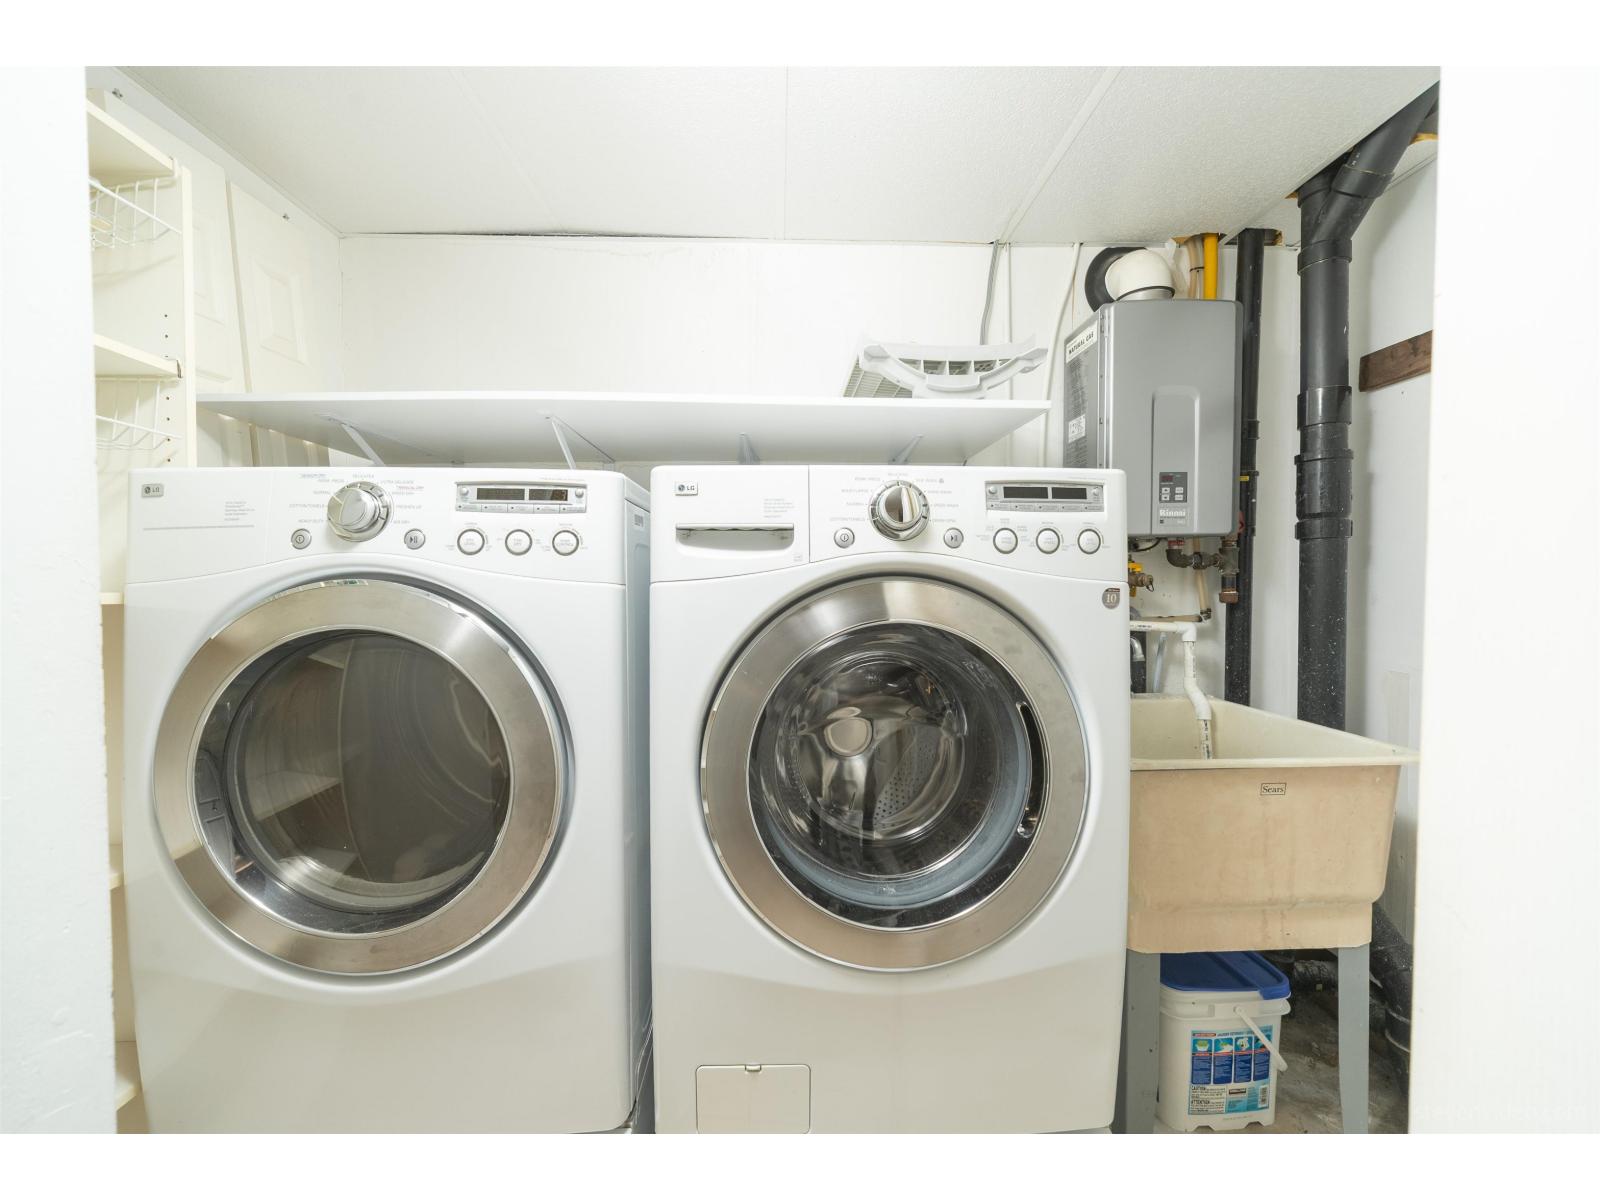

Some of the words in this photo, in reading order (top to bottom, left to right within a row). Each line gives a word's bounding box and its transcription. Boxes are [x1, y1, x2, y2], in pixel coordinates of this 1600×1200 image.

[1159, 509, 1186, 517] Rinnai
[1106, 593, 1117, 603] 10
[1262, 785, 1284, 793] Sears
